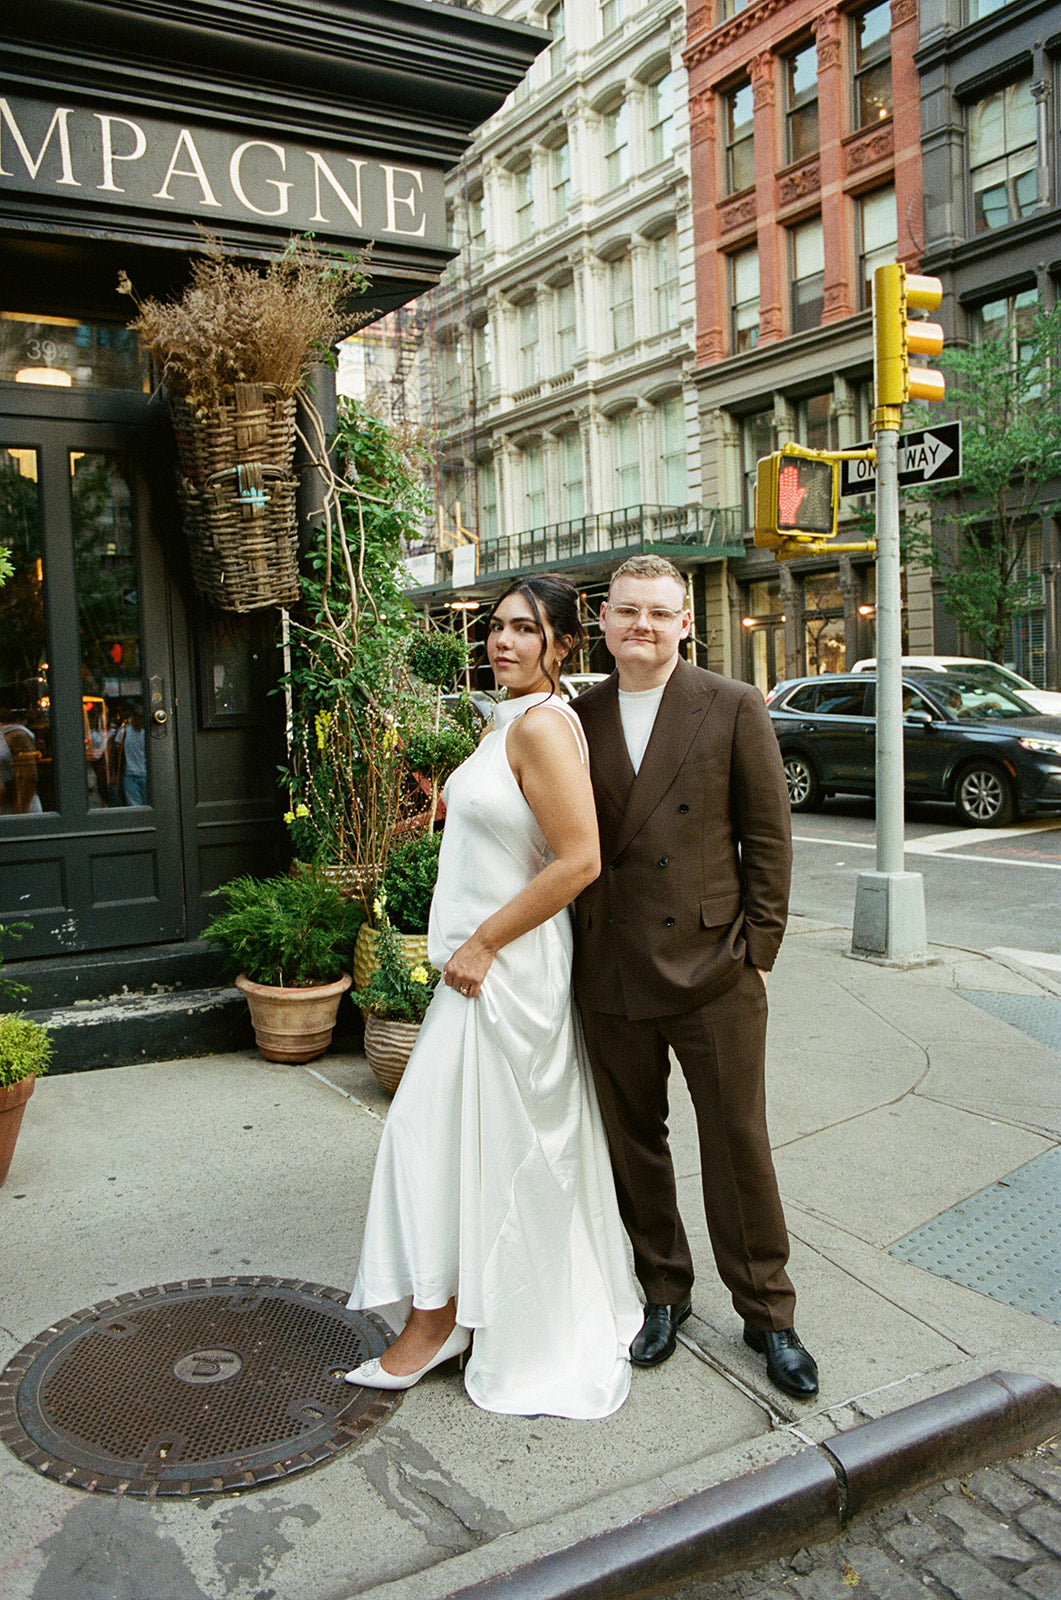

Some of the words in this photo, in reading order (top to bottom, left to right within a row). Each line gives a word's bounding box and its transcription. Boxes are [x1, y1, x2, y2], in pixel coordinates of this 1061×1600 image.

[0, 97, 426, 237] MPAGNE
[857, 459, 876, 478] ON
[905, 443, 940, 469] WAY
